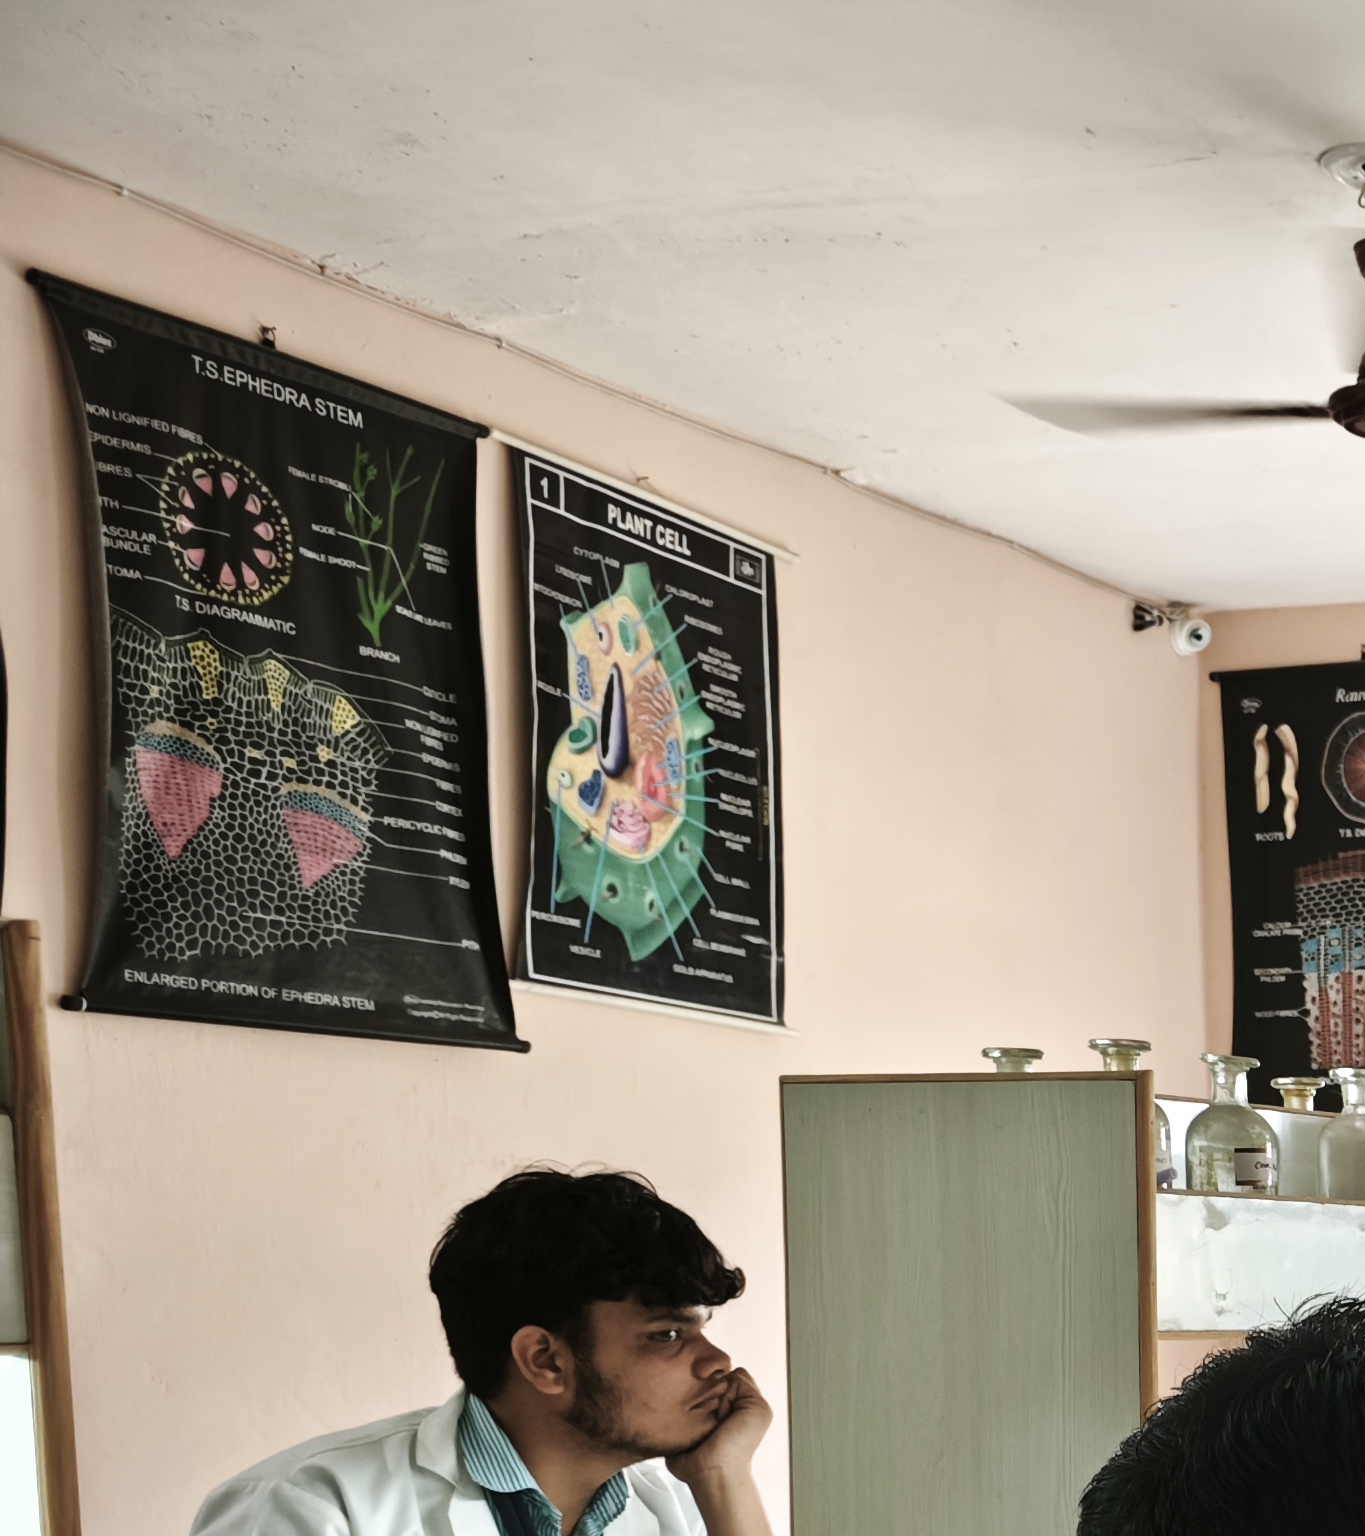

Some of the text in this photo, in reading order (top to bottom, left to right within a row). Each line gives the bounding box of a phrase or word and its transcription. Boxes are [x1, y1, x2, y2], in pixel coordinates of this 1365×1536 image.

[193, 355, 363, 428] T.S.EPHEDRA STEM
[85, 402, 203, 445] NON LIGNIFIED FIBRES
[95, 460, 132, 479] IBRES
[540, 477, 549, 499] 1
[101, 523, 157, 545] ASCULAR
[607, 503, 691, 557] PLANT CELL
[102, 536, 151, 556] BUNDLE
[195, 601, 296, 635] DIAGRAMMATIC
[359, 646, 400, 663] BRANCH
[125, 969, 375, 1010] ENLARGED PORTION OF EPHEDRA STEM
